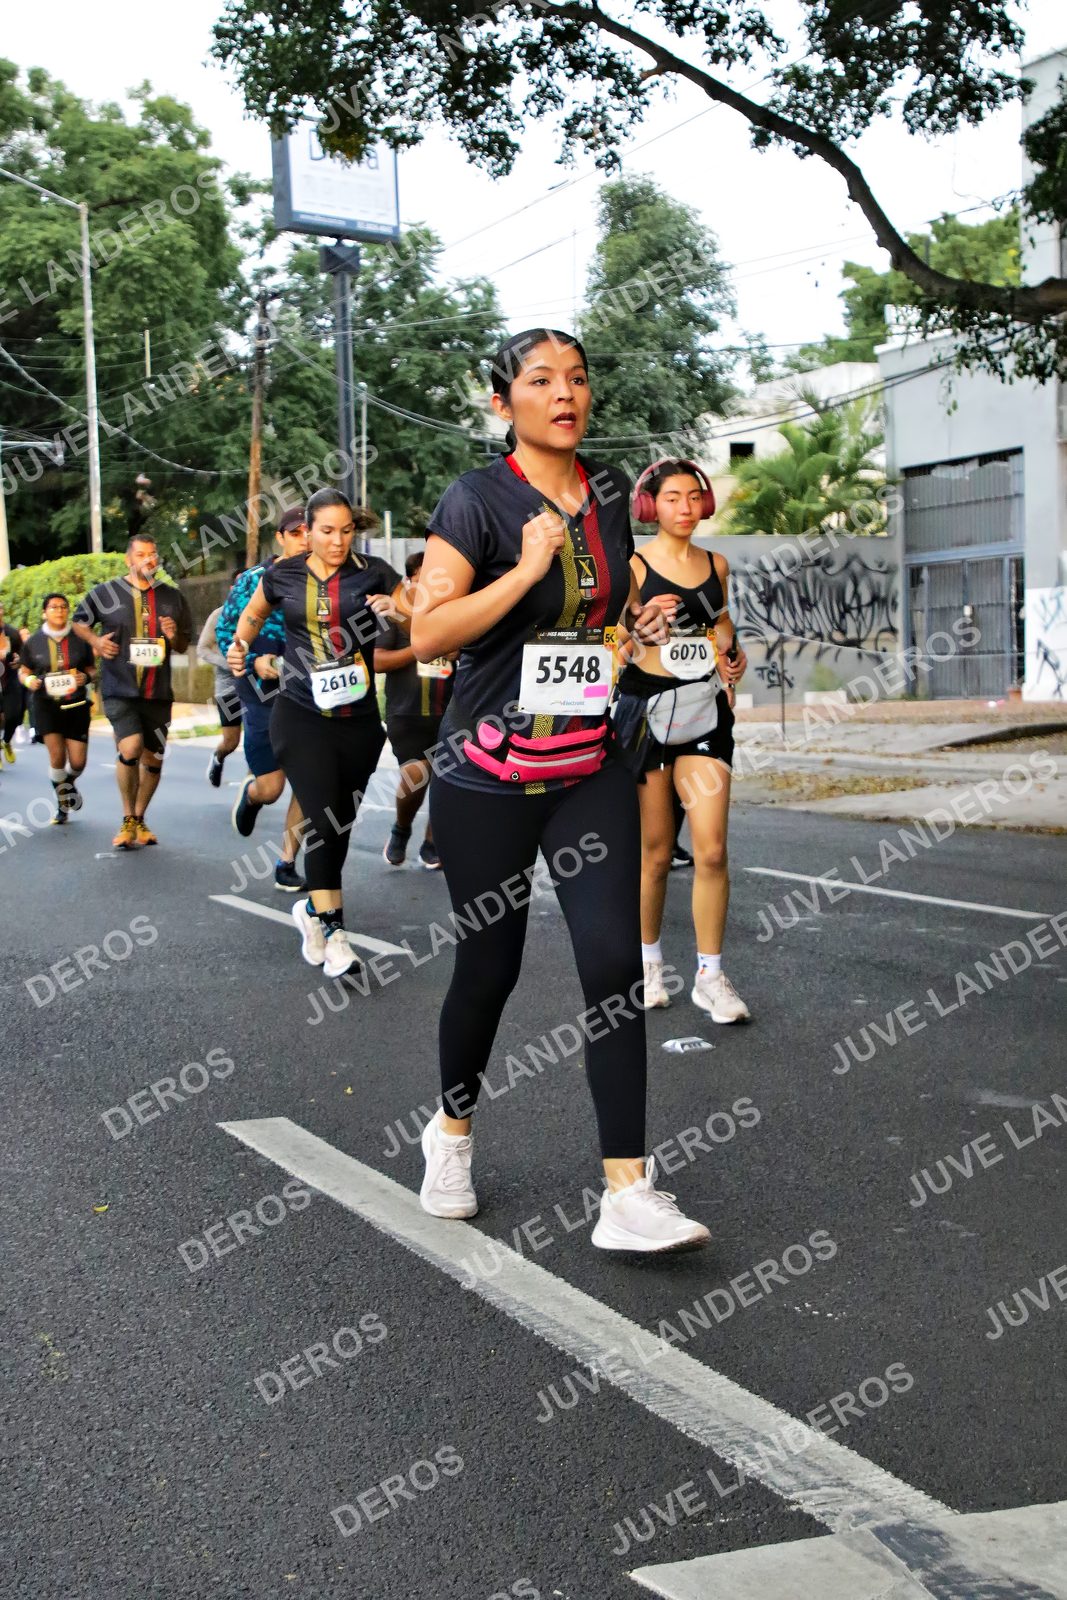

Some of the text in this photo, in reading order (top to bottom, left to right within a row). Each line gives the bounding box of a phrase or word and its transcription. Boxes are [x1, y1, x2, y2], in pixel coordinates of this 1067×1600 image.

[604, 633, 615, 643] 5K
[135, 647, 158, 656] 2418
[670, 643, 707, 660] 6070
[536, 656, 601, 684] 5548
[320, 671, 358, 693] 2616
